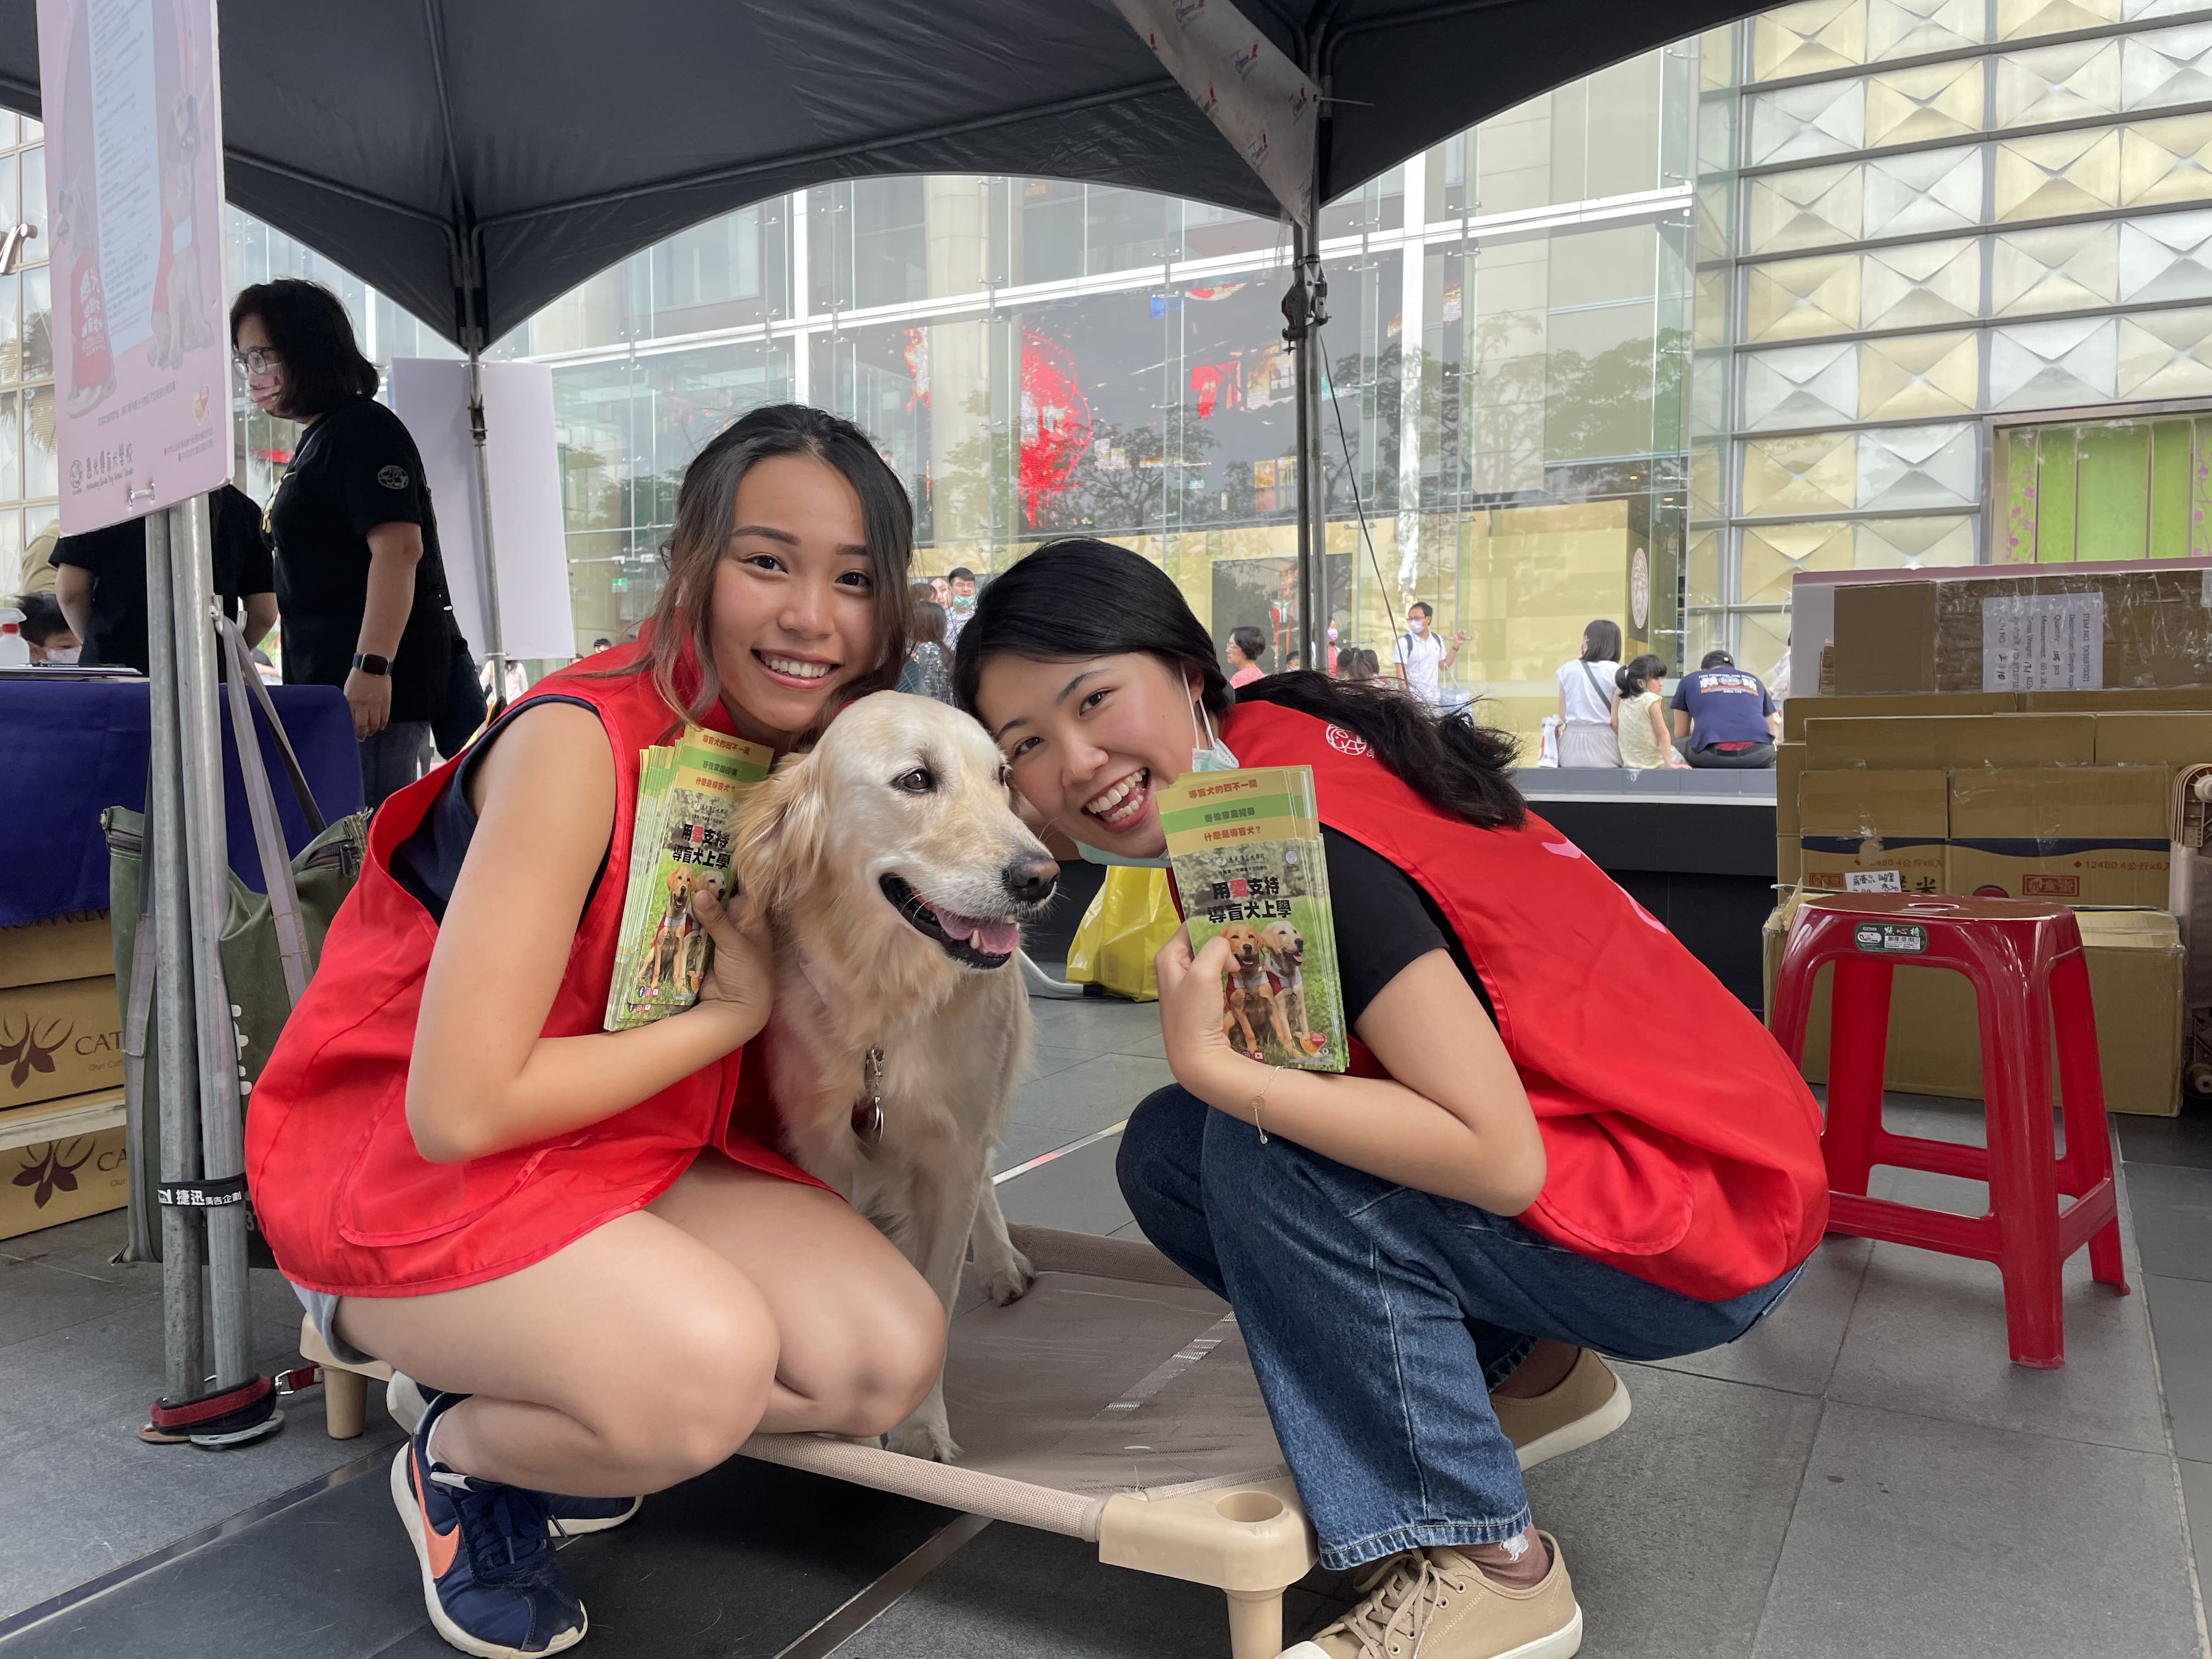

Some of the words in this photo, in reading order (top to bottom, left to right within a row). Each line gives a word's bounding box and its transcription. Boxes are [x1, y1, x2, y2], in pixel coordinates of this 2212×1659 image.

[2067, 653, 2076, 673] Simple
[681, 823, 730, 848] 用愛支持
[673, 844, 731, 869] 導盲犬上學
[1212, 877, 1279, 900] 用愛支持
[1207, 900, 1291, 923] 導盲犬上學
